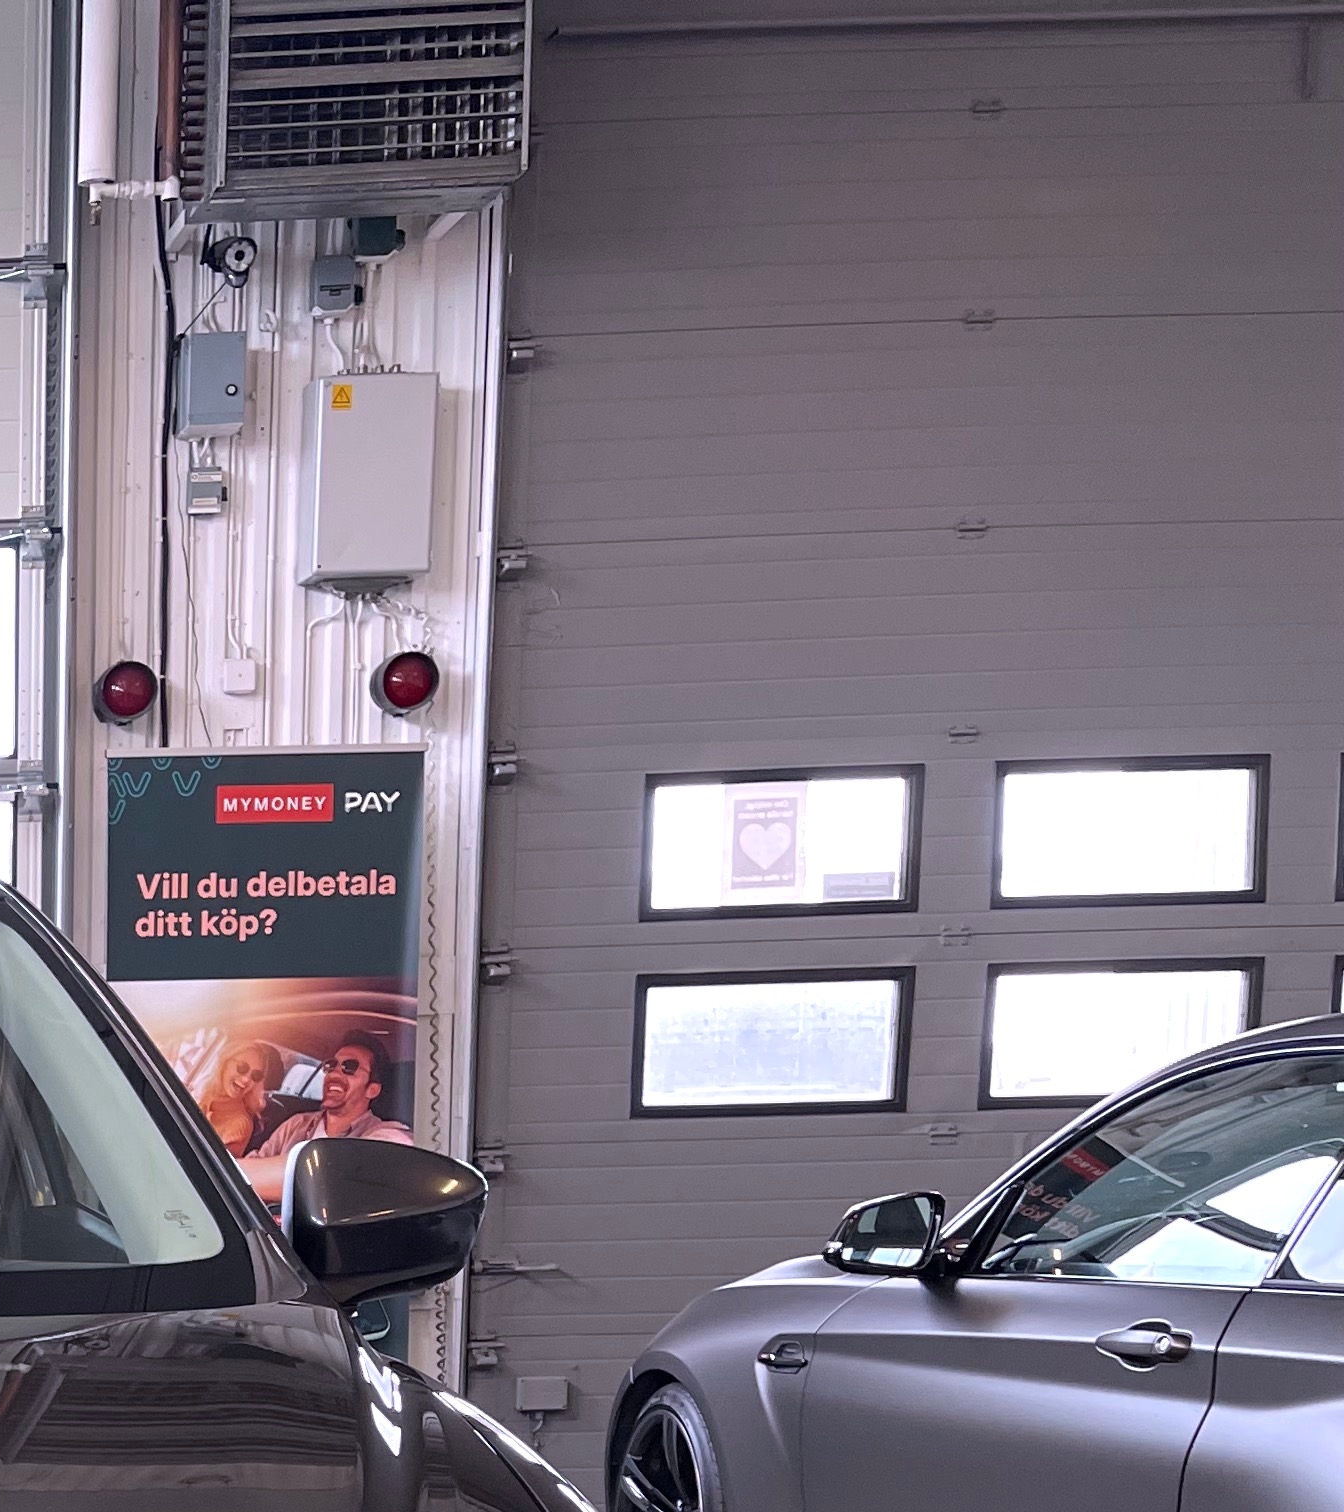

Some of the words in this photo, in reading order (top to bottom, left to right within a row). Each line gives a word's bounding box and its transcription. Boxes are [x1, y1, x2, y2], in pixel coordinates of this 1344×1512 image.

[223, 796, 327, 812] MYMONEY
[344, 791, 401, 813] PAY
[136, 872, 189, 900] Vill
[196, 872, 238, 899] du
[246, 868, 397, 898] delbetala
[135, 909, 192, 938] ditt
[201, 908, 279, 942] köp?
